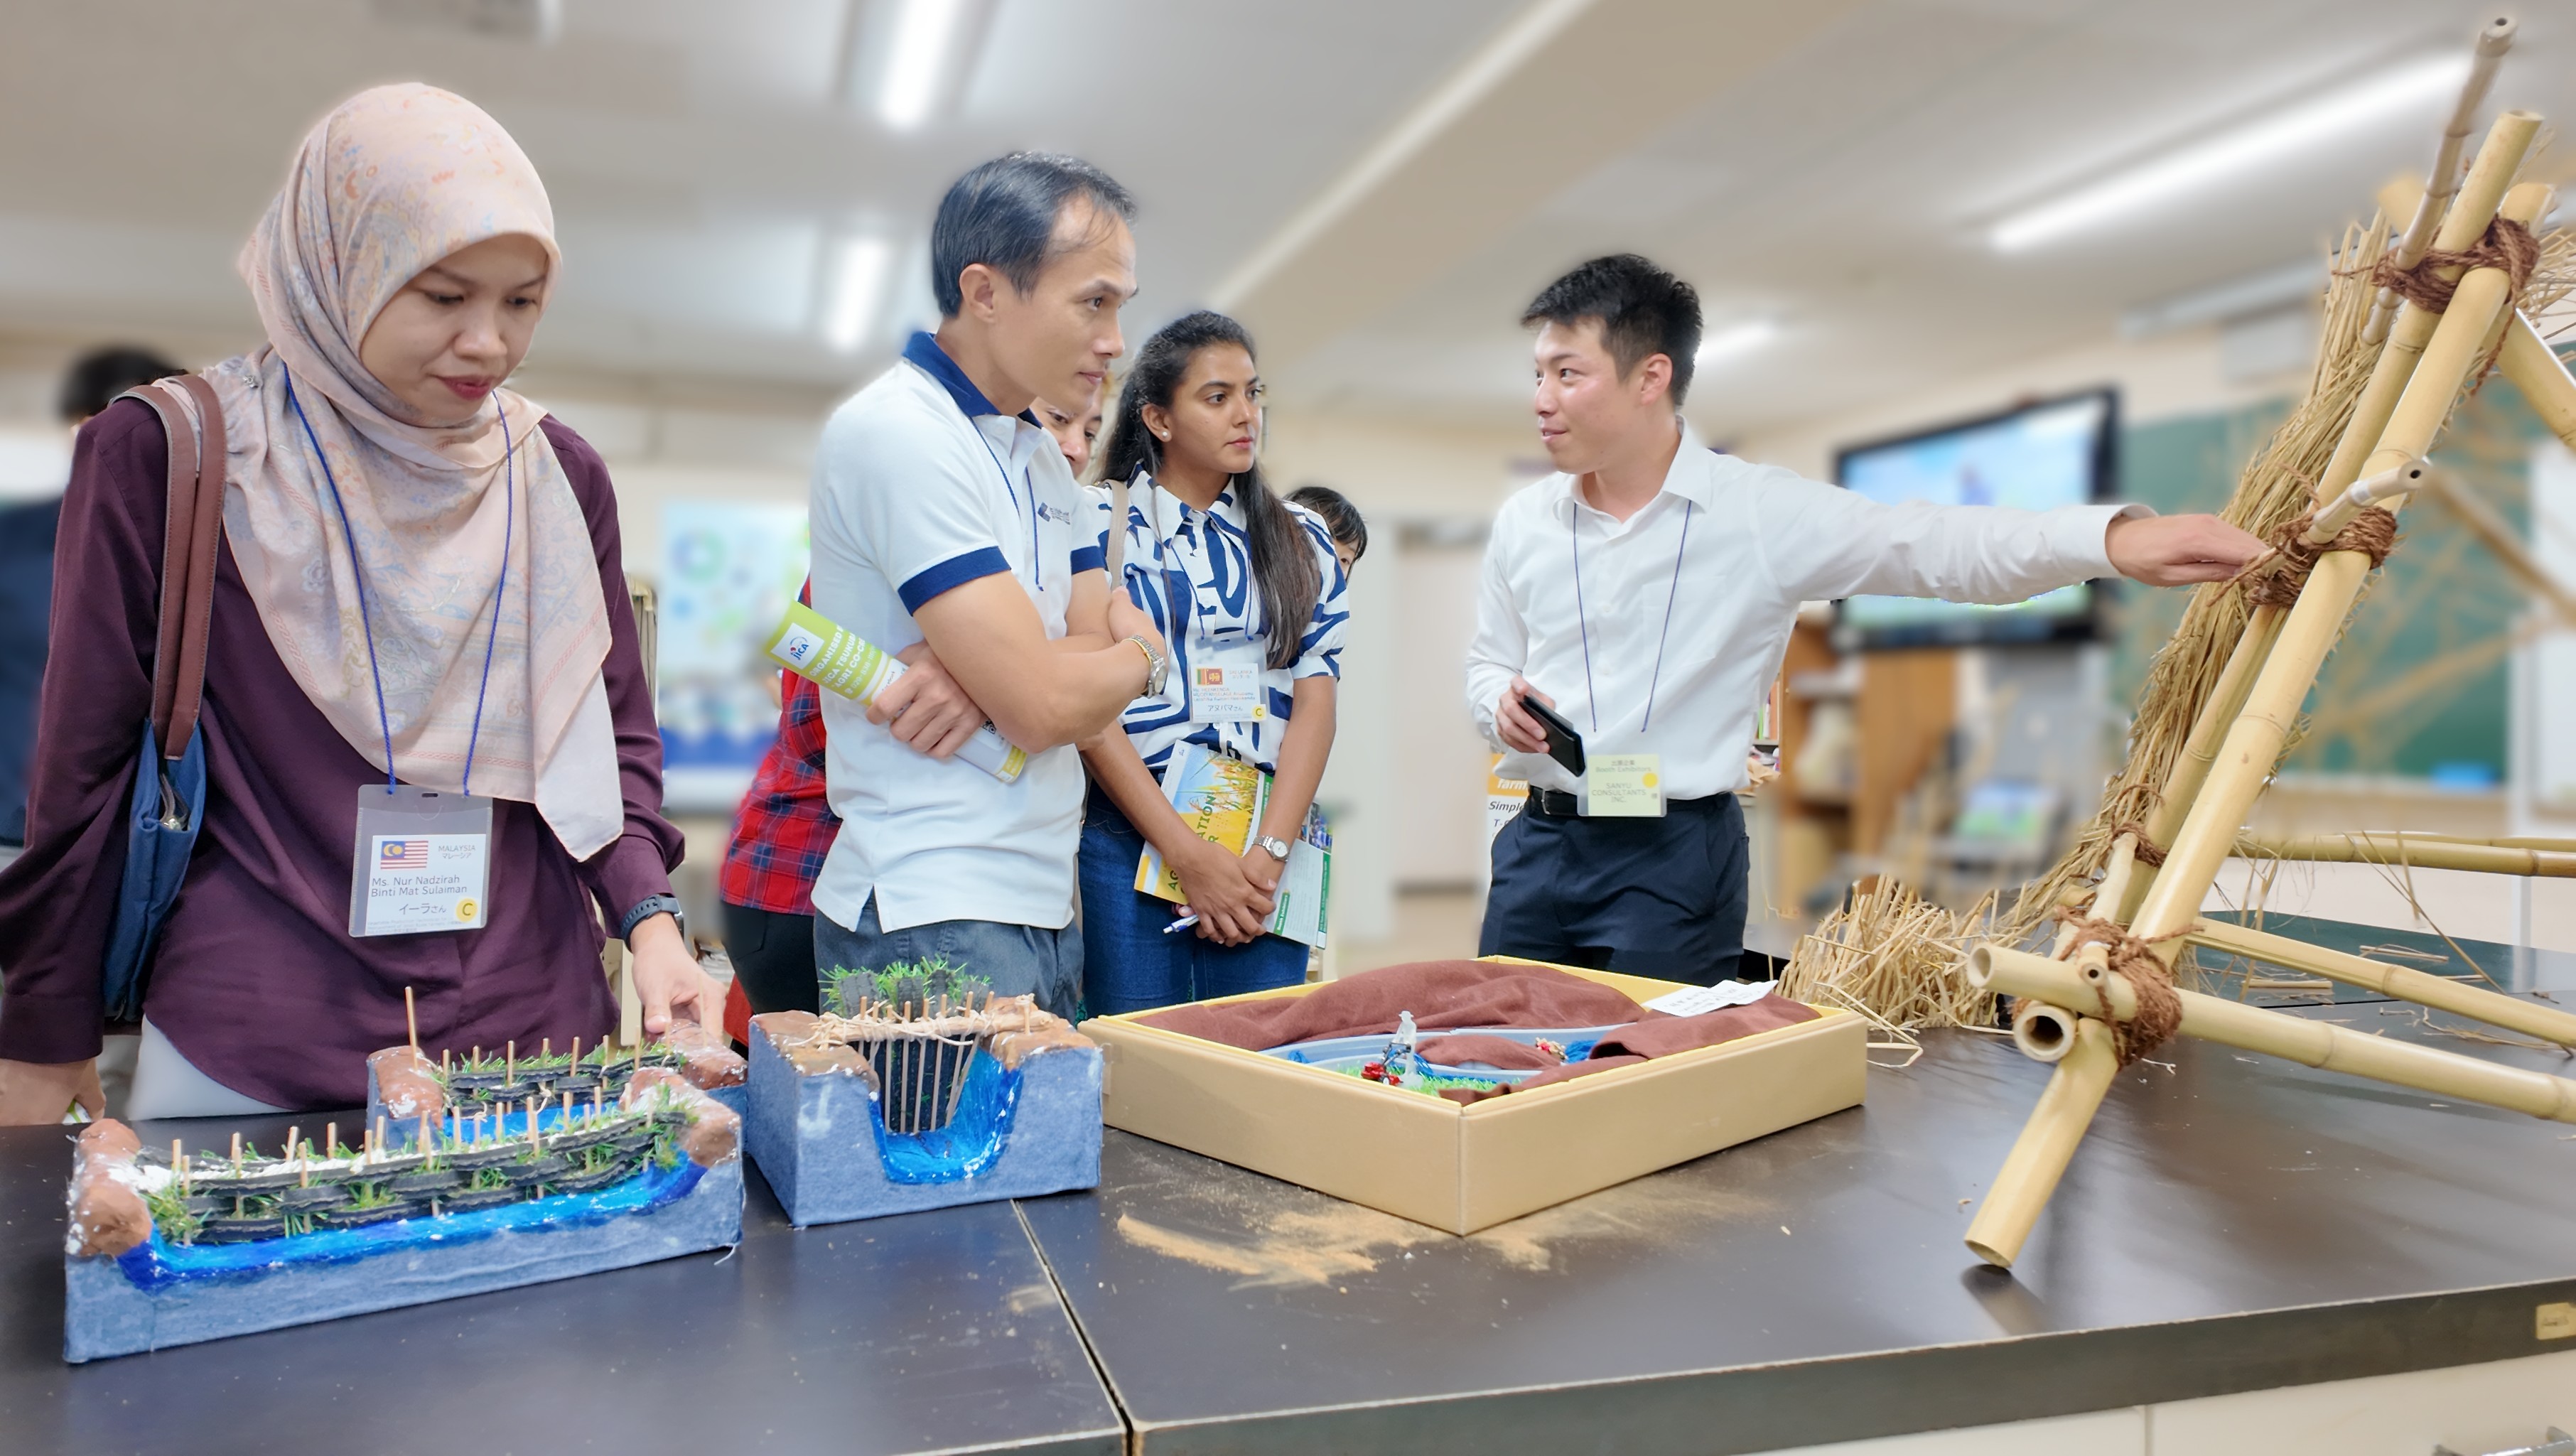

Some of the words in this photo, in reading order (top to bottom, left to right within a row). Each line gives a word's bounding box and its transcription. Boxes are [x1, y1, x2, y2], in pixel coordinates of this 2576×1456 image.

[809, 631, 844, 676] ORGANISED
[822, 667, 841, 684] JICA
[1255, 708, 1262, 717] C
[1497, 777, 1529, 791] farm
[438, 844, 476, 853] MALAYSIA
[372, 878, 389, 887] Ms.
[393, 877, 413, 886] Nur
[416, 874, 460, 885] Nadzirah
[371, 888, 396, 897] Binti
[399, 887, 419, 897] Mat
[422, 885, 468, 895] Sulaiman
[399, 902, 446, 915] イーラさん
[462, 902, 474, 917] C
